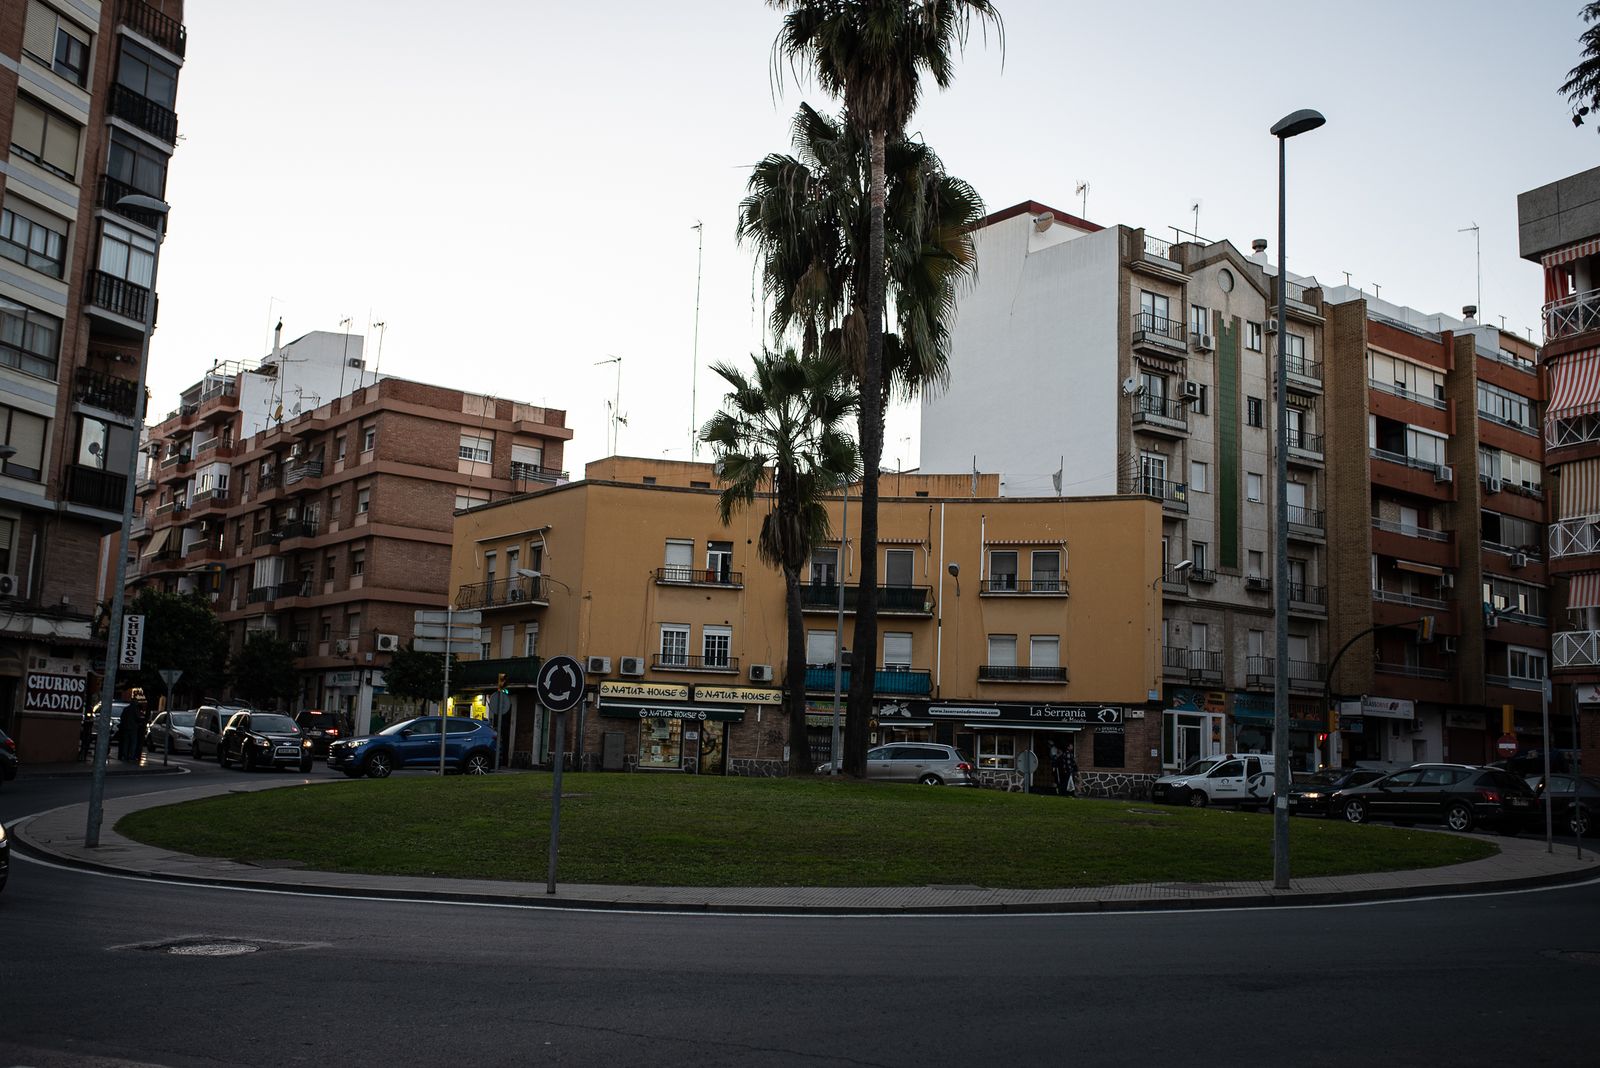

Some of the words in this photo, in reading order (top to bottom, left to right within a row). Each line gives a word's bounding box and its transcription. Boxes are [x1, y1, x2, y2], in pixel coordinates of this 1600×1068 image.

[124, 616, 139, 663] CHURROS
[28, 674, 85, 692] CHURROS
[610, 685, 645, 695] NATUR
[647, 687, 678, 697] HOUSE
[704, 690, 739, 700] NATUR
[741, 691, 771, 701] HOUSE
[26, 692, 83, 710] MADRID
[648, 709, 673, 718] NATUR
[674, 710, 697, 719] HOUSE
[1029, 706, 1042, 717] La
[1044, 707, 1086, 718] Serranía
